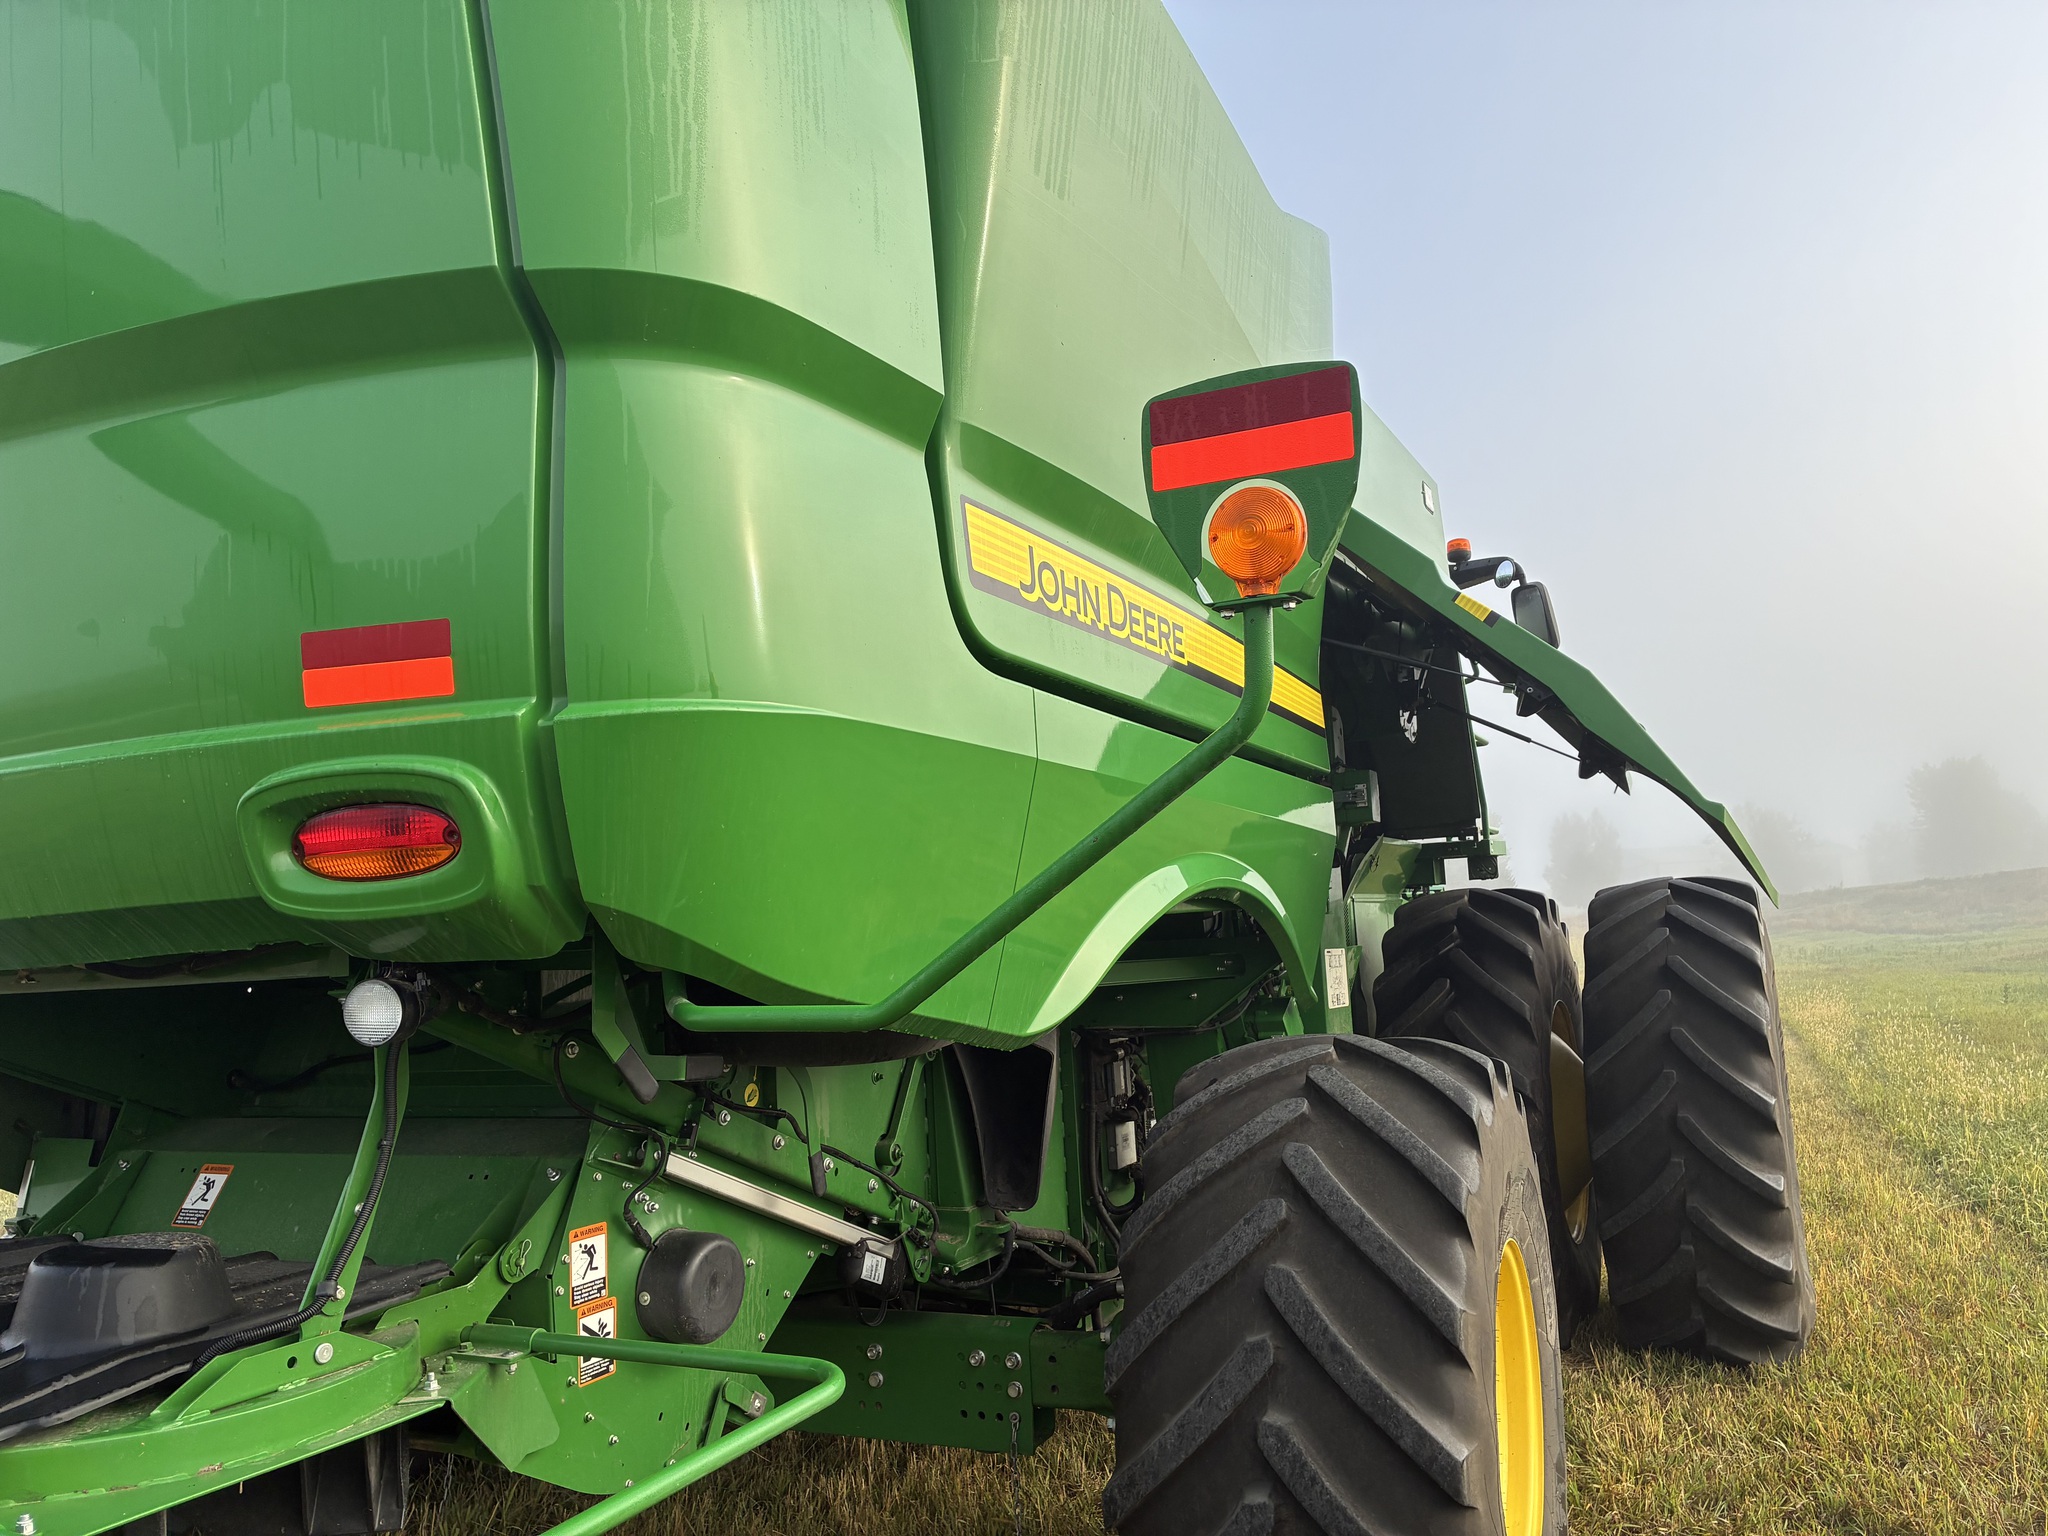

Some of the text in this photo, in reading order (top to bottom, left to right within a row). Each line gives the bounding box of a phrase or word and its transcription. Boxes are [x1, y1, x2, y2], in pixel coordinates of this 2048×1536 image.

[1019, 545, 1185, 659] JOHN DEERE
[579, 1225, 604, 1237] WARNING
[586, 1300, 613, 1313] WARNING
